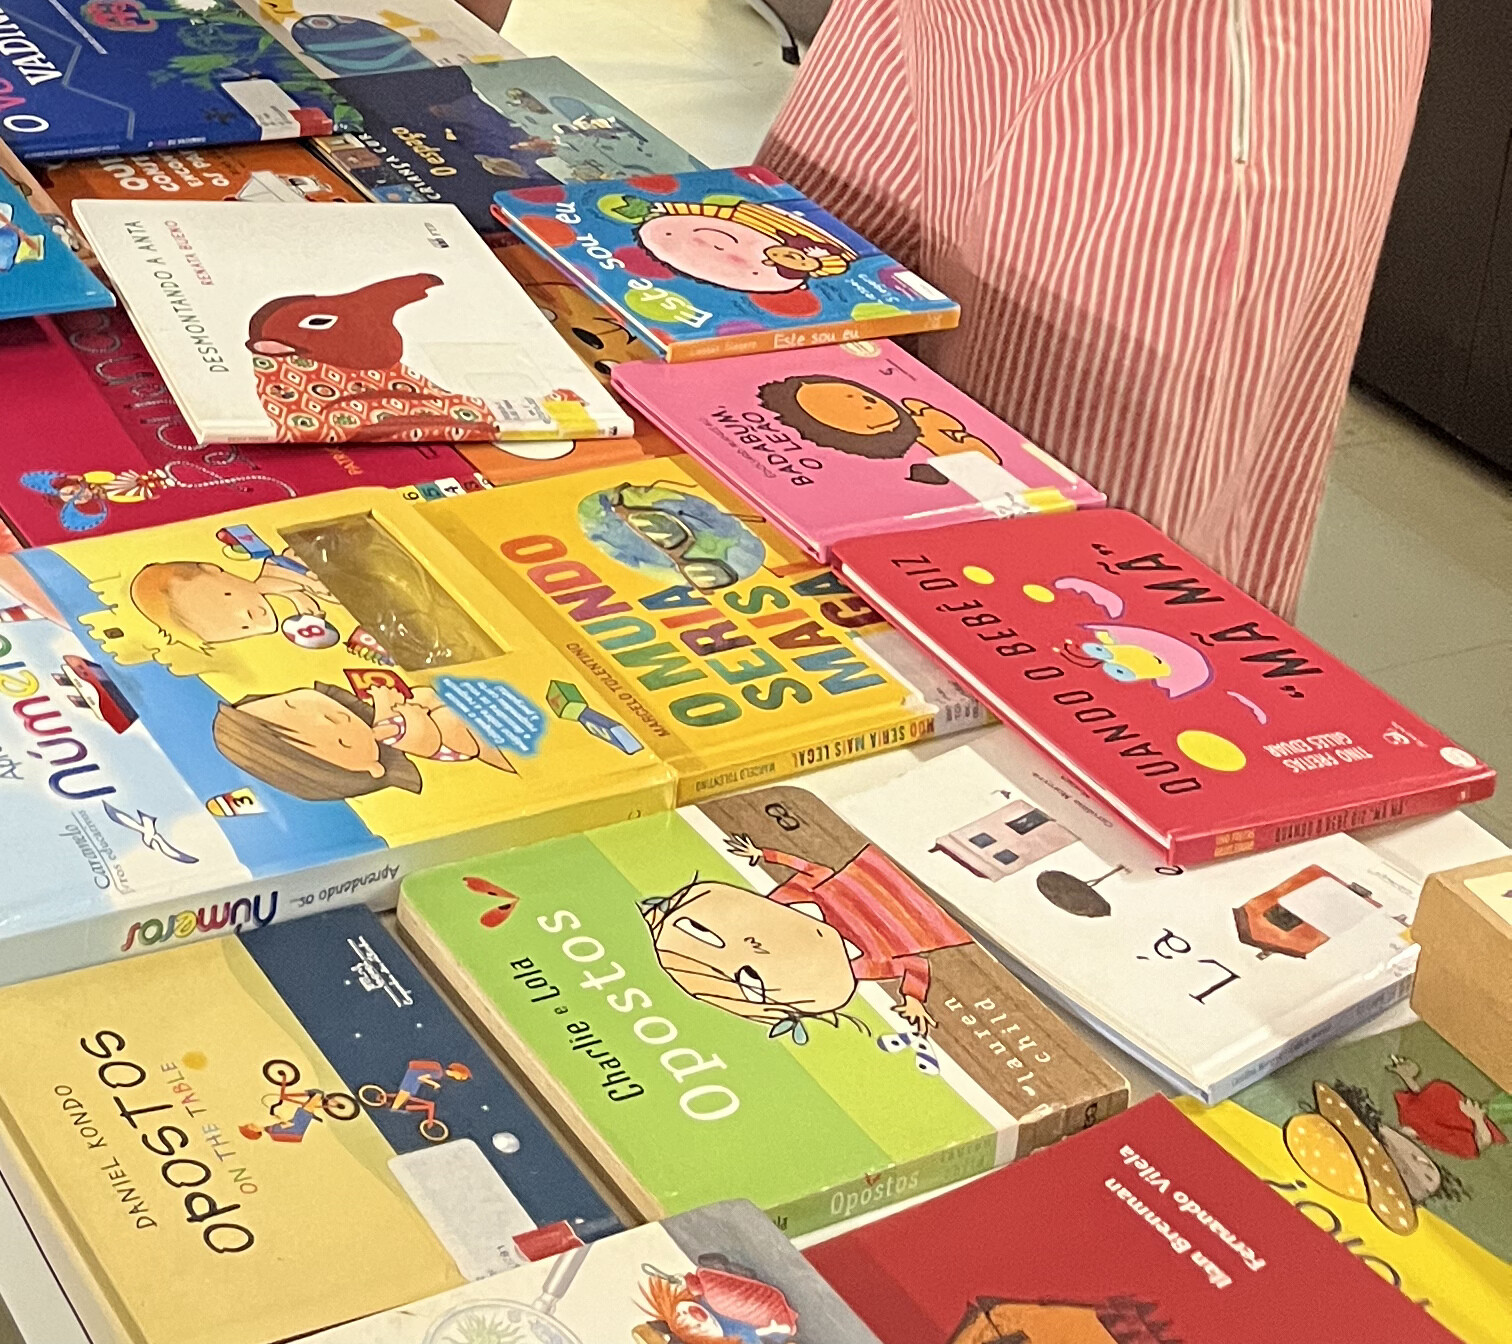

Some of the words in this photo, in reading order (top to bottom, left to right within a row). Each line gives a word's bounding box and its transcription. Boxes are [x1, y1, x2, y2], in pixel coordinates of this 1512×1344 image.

[2, 113, 49, 134] O
[392, 127, 445, 164] espaço
[386, 155, 441, 200] CRIANÇA
[430, 166, 457, 176] O
[124, 220, 151, 248] ANTA
[164, 219, 195, 248] BUENO
[555, 202, 582, 225] eu
[178, 247, 214, 286] RENATA
[576, 235, 626, 271] sou
[152, 270, 229, 373] DESMONTANDO
[627, 279, 713, 328] Este
[774, 332, 806, 346] Este
[811, 330, 838, 342] sou
[843, 327, 860, 339] eu
[715, 404, 815, 487] BADABUM,
[740, 409, 812, 455] LEÃO
[799, 457, 823, 472] O
[890, 553, 959, 593] DIZ
[500, 534, 697, 690] MUNDO
[961, 599, 1038, 659] BEBÊ
[637, 586, 810, 711] SERIA
[726, 584, 889, 695] MAIS
[1023, 666, 1065, 683] O
[670, 690, 743, 728] O
[835, 734, 865, 756] MAIS
[870, 725, 906, 748] SERIA
[1053, 689, 1205, 796] QUANDO
[1262, 739, 1312, 757] EDUAR
[1306, 731, 1352, 749] GILLES
[1335, 746, 1373, 762] TINO
[1282, 751, 1339, 773] FREITAS
[62, 816, 114, 891] Caramelo
[290, 891, 315, 908] os
[316, 862, 400, 904] Aprendendo
[509, 956, 562, 1007] Lola
[1137, 928, 1241, 1005] Lá
[536, 908, 742, 1122] Opostos
[553, 1006, 570, 1021] e
[974, 997, 1052, 1065] child
[571, 1017, 646, 1104] Charlie
[942, 996, 1034, 1084] lauren
[159, 1060, 208, 1119] TABLE
[54, 1082, 106, 1150] KONDO
[80, 1029, 256, 1254] OPOSTOS
[200, 1121, 242, 1164] THE
[227, 1166, 259, 1196] ON
[1117, 1143, 1173, 1194] Vilela
[99, 1156, 159, 1230] DANIEL
[829, 1166, 919, 1220] Opostos
[1104, 1176, 1191, 1256] Brenman
[1168, 1189, 1267, 1272] Fernando
[1186, 1249, 1233, 1291] Ilan
